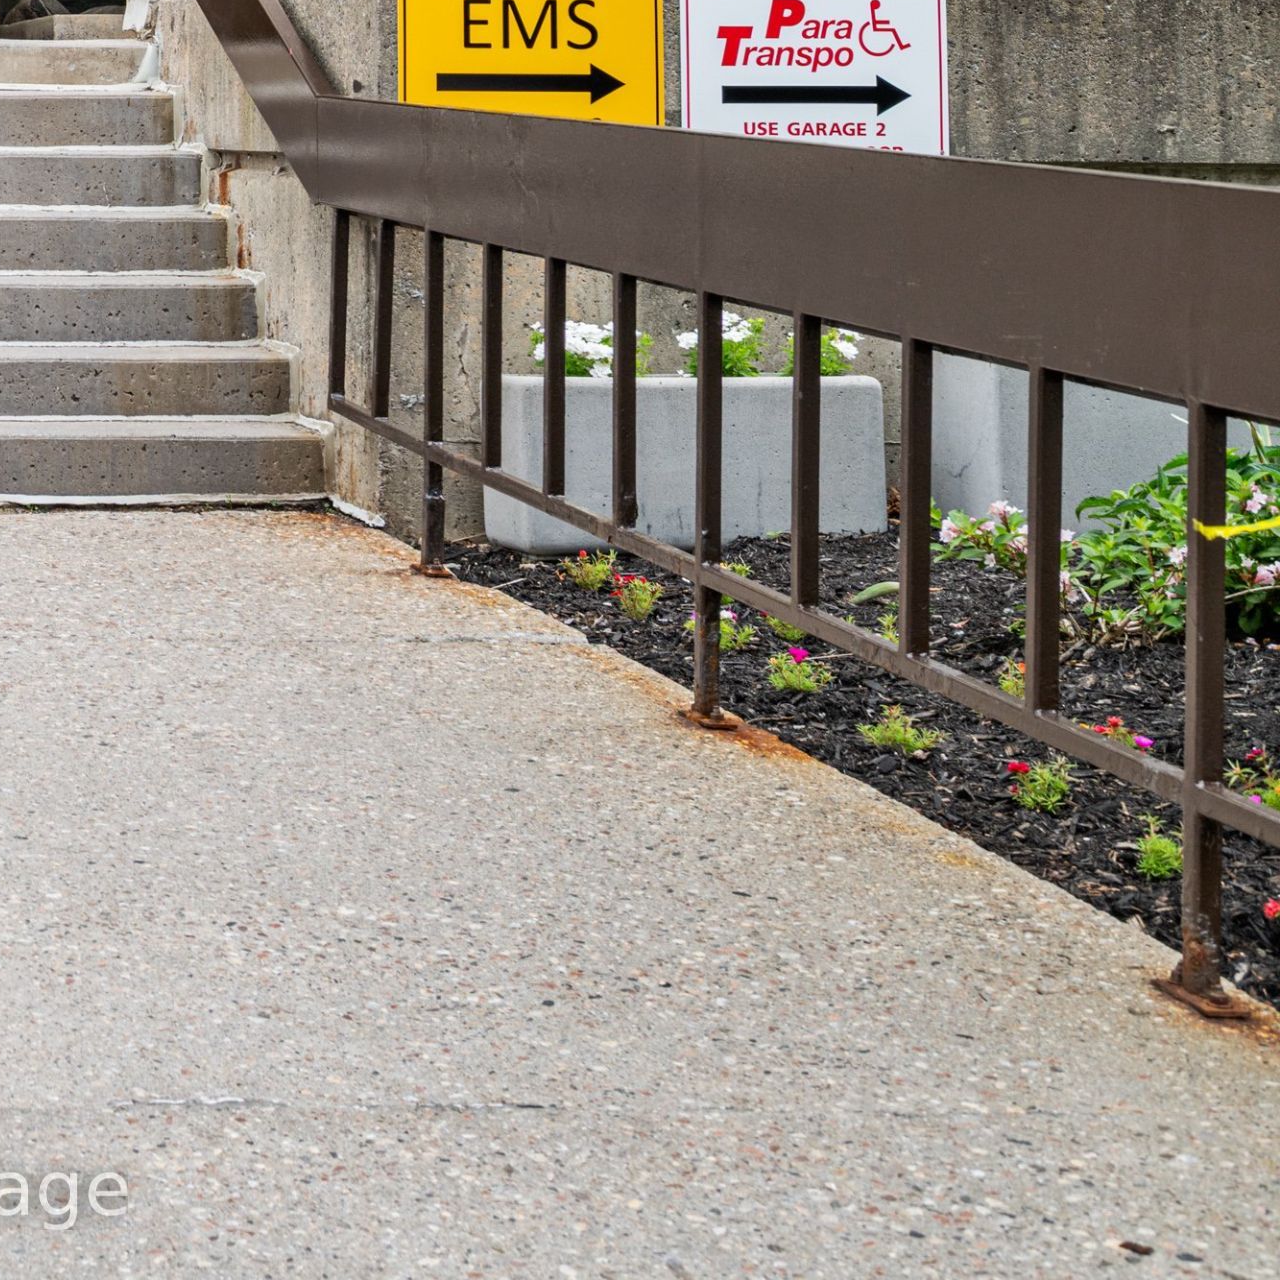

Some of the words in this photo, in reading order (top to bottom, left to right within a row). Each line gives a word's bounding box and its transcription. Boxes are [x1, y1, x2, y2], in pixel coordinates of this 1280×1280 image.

[716, 25, 855, 73] Transpo
[743, 122, 779, 136] USE
[786, 122, 867, 137] GARAGE
[875, 123, 887, 137] 2
